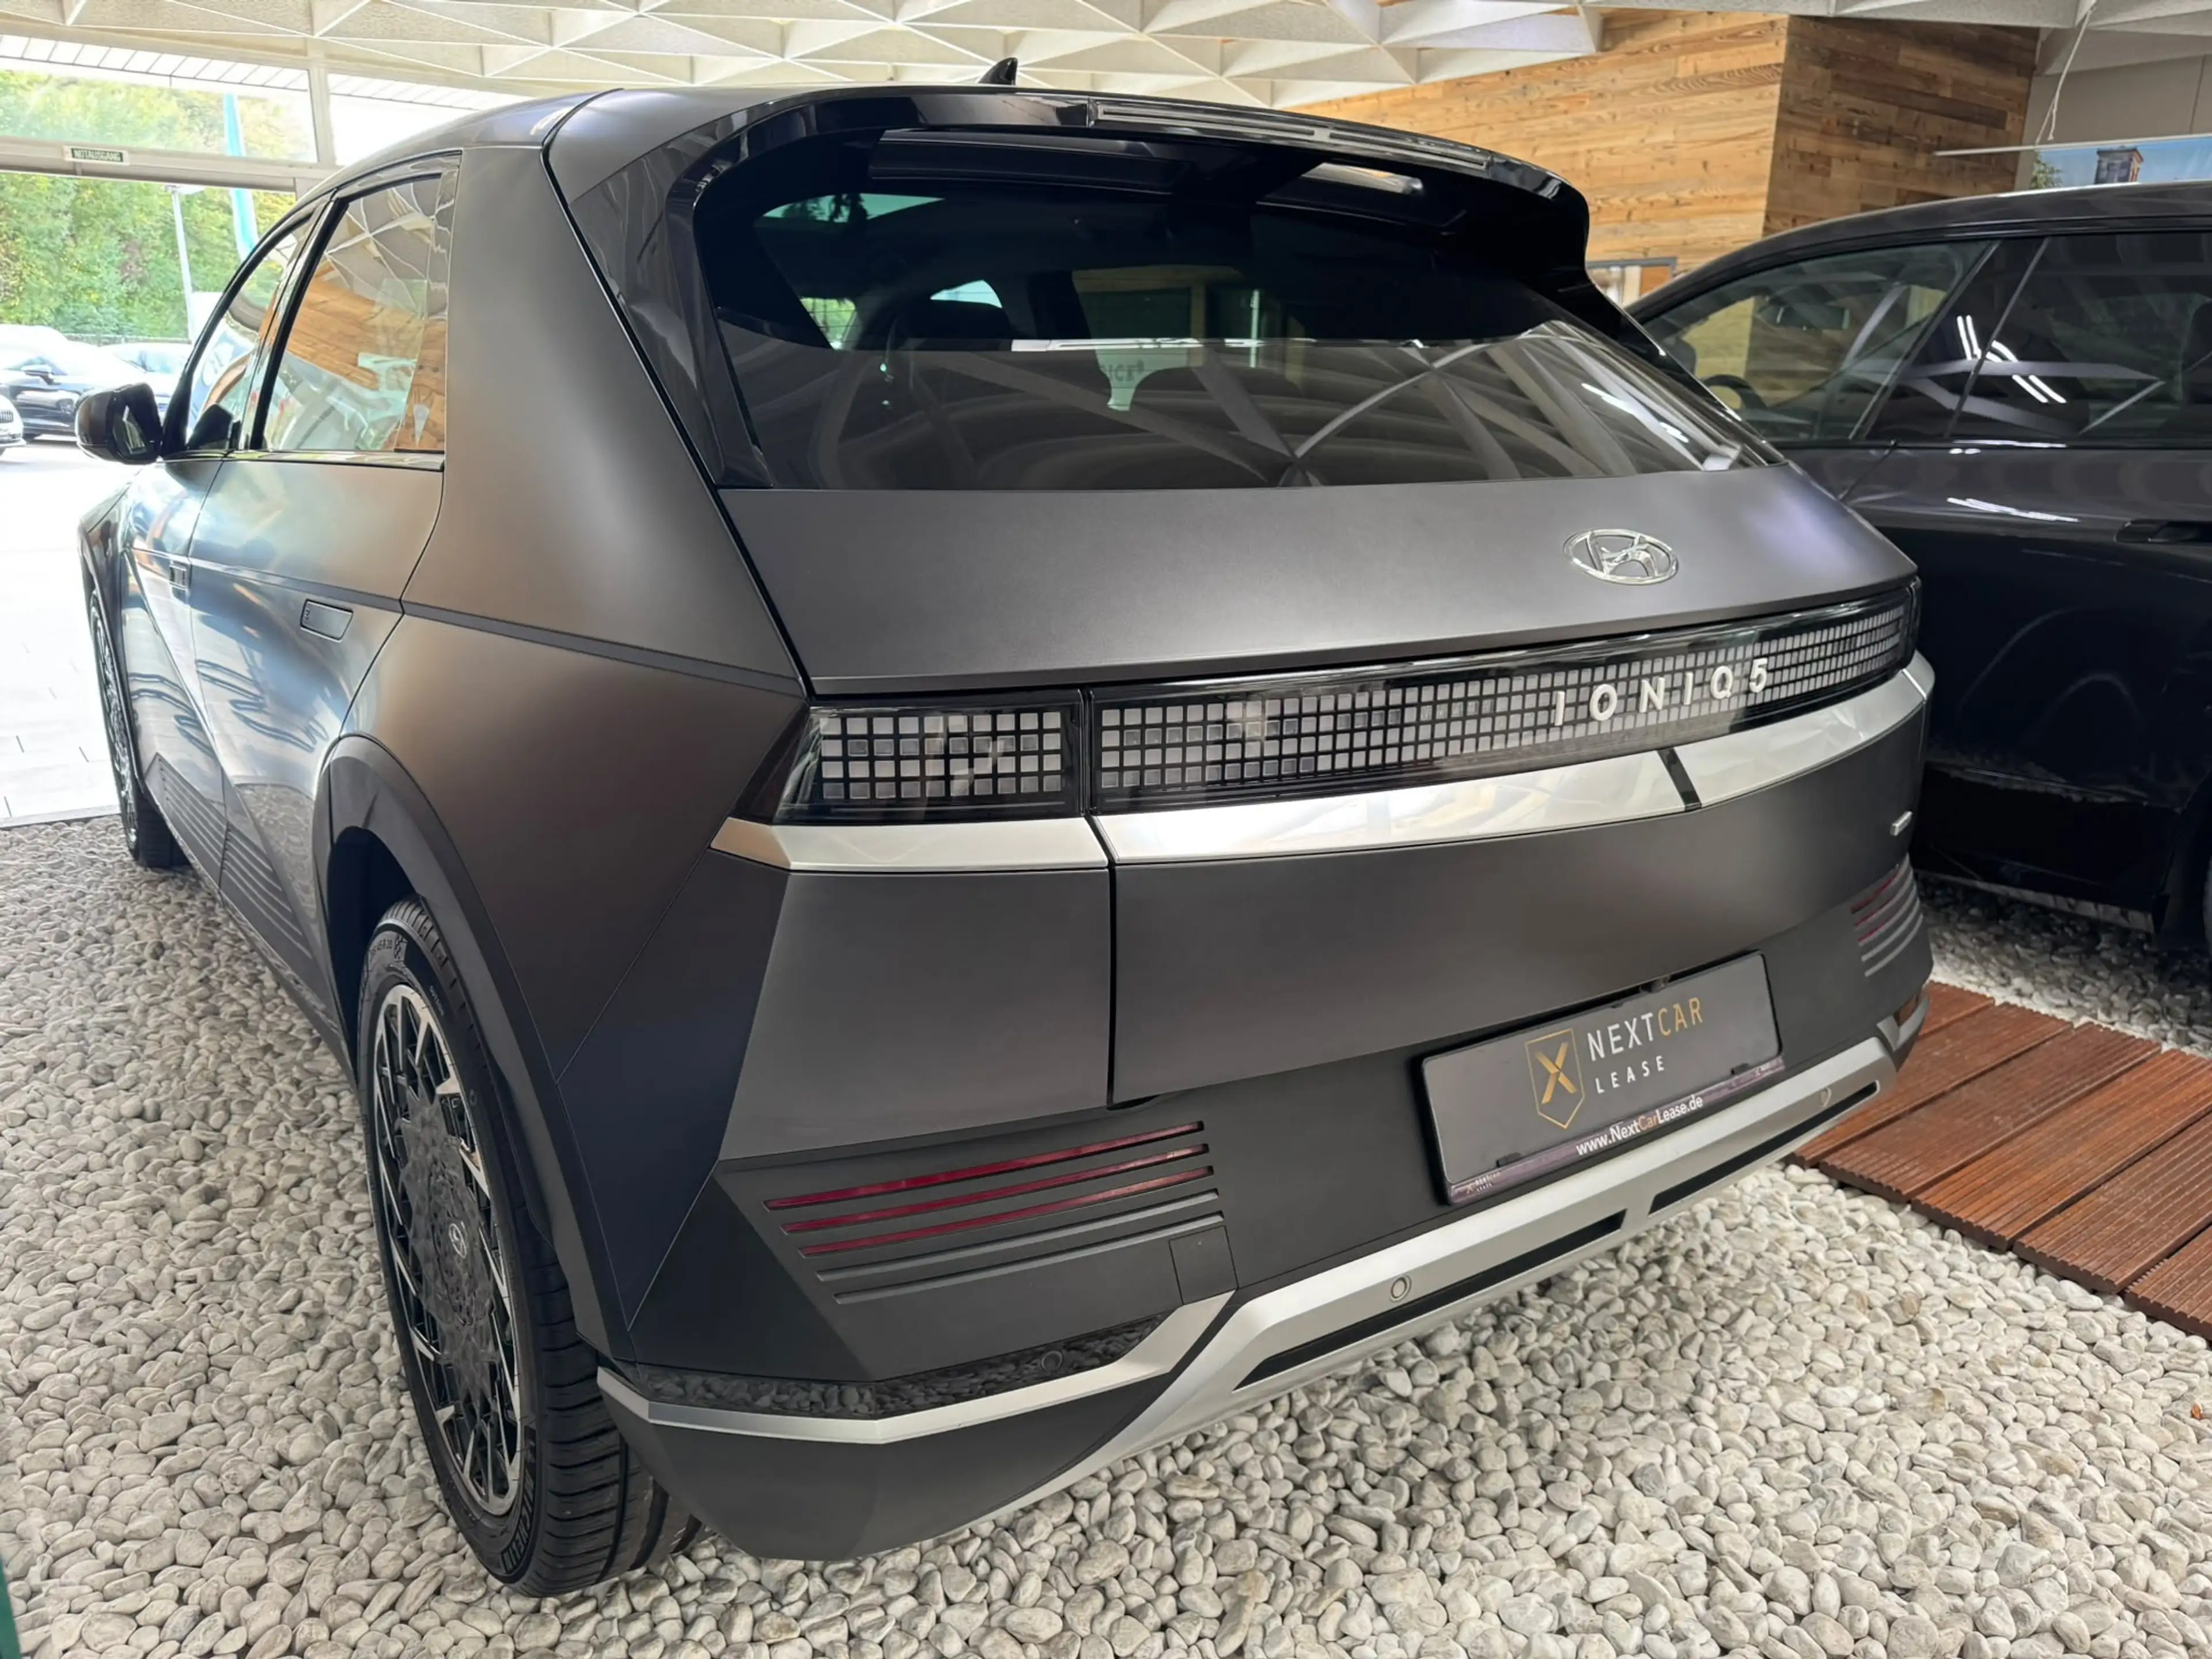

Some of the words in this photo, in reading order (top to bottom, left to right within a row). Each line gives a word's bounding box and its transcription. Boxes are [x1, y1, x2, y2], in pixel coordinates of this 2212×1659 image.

[1554, 665, 1734, 726] IONIQ
[1748, 657, 1768, 694] 5
[1587, 997, 1703, 1062] NEXTCAR
[1595, 1055, 1665, 1094] LEASE
[1575, 1094, 1703, 1156] www.NextCarLease.de
